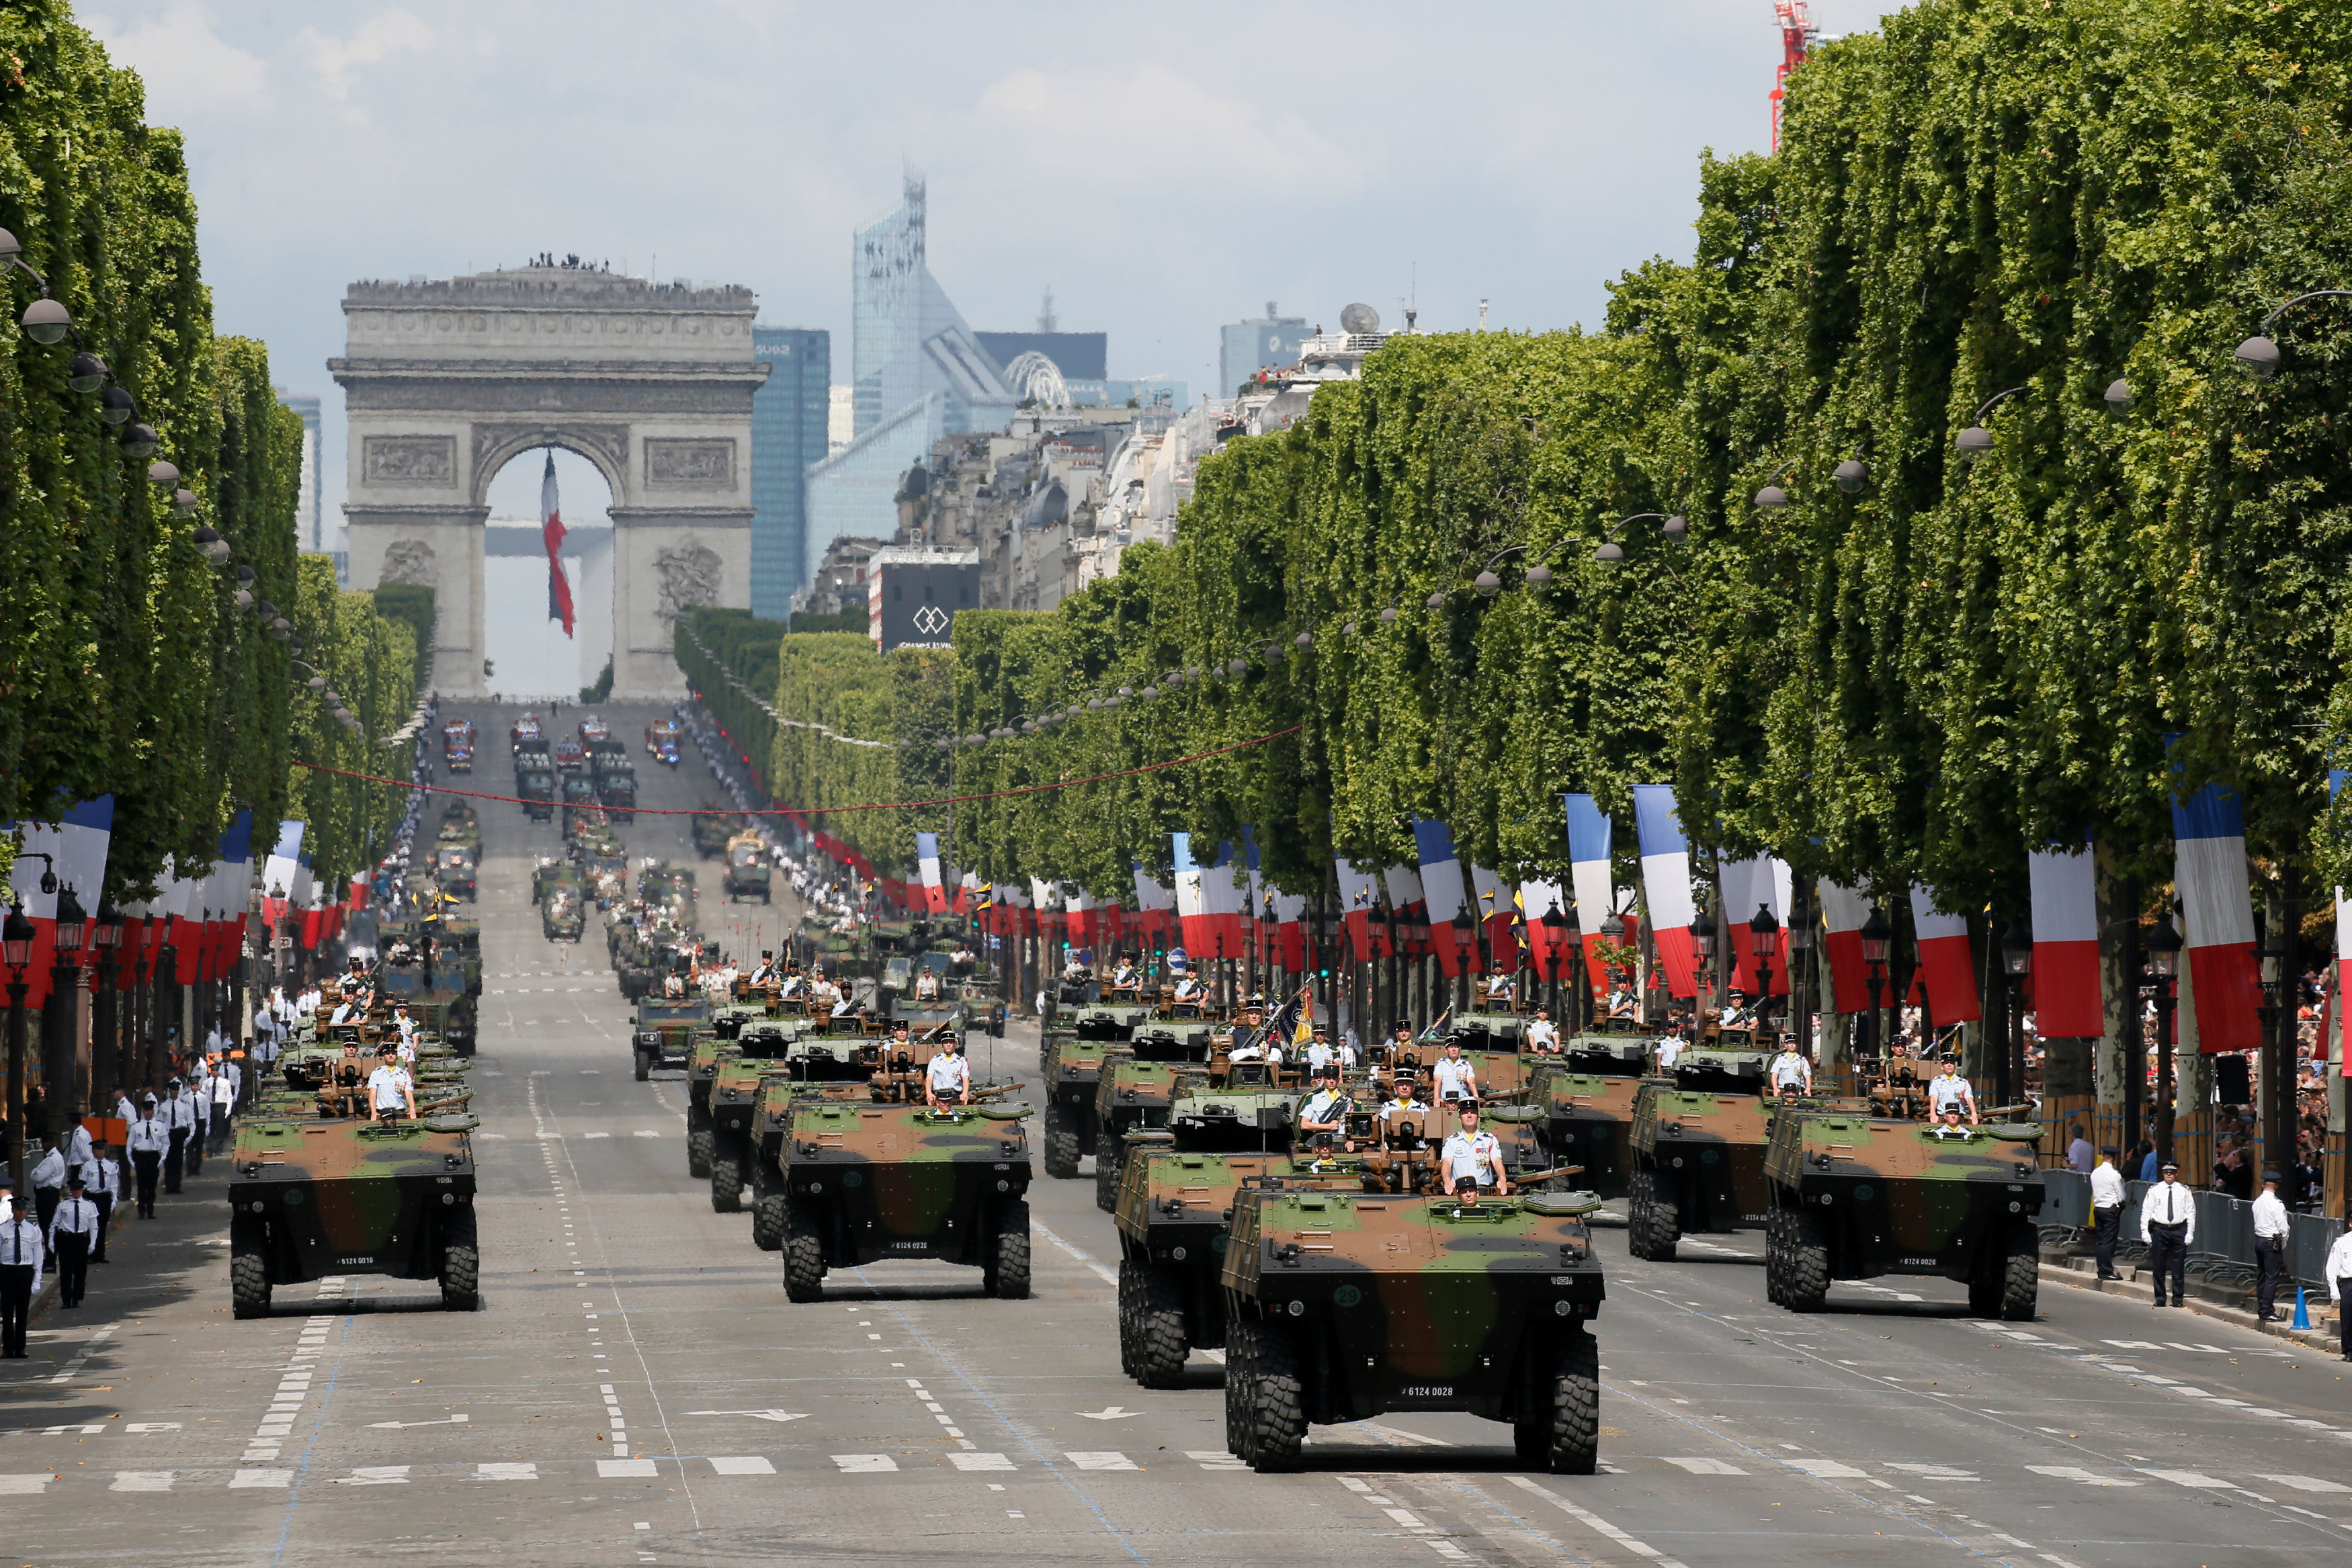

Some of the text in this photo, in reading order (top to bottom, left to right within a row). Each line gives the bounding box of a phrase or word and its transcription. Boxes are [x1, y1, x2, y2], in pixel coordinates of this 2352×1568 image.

[1338, 1289, 1357, 1303] 29
[1409, 1387, 1454, 1396] 6124 0028
